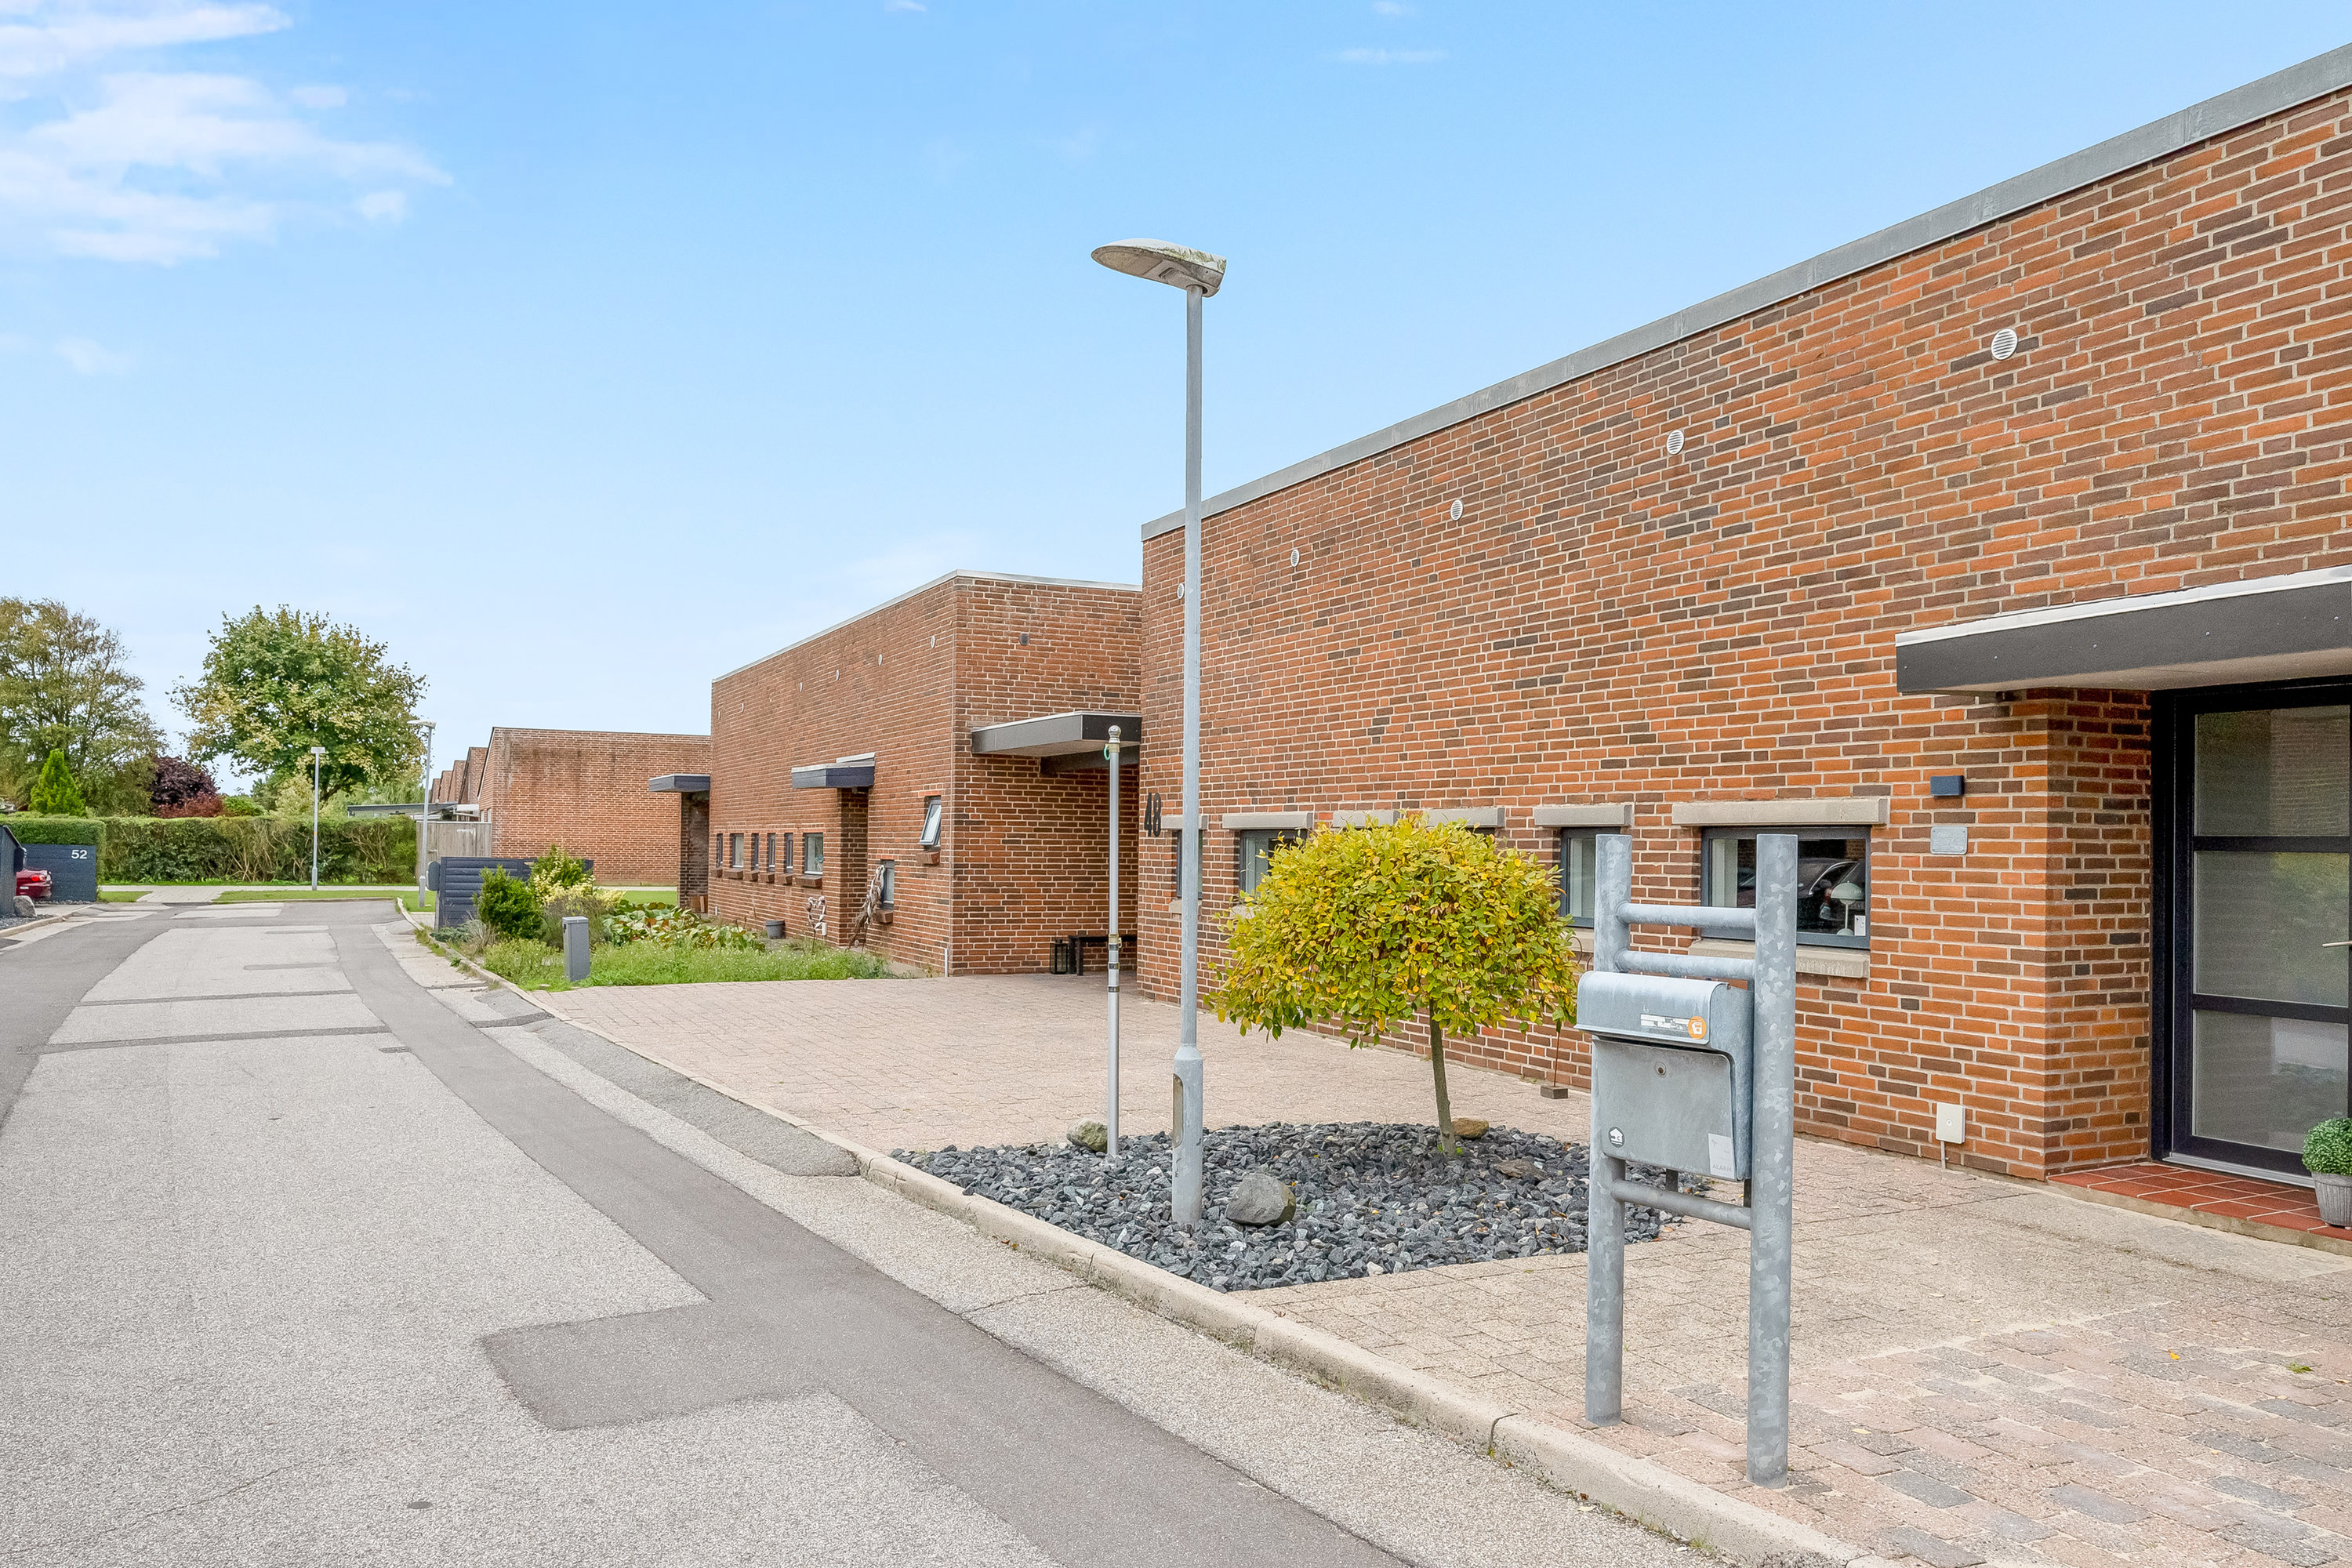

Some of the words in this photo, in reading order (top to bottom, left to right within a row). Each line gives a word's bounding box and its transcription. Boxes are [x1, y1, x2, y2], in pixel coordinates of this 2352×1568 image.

[1144, 793, 1161, 837] 48
[71, 850, 87, 859] 52
[1711, 1163, 1732, 1173] ALARM
